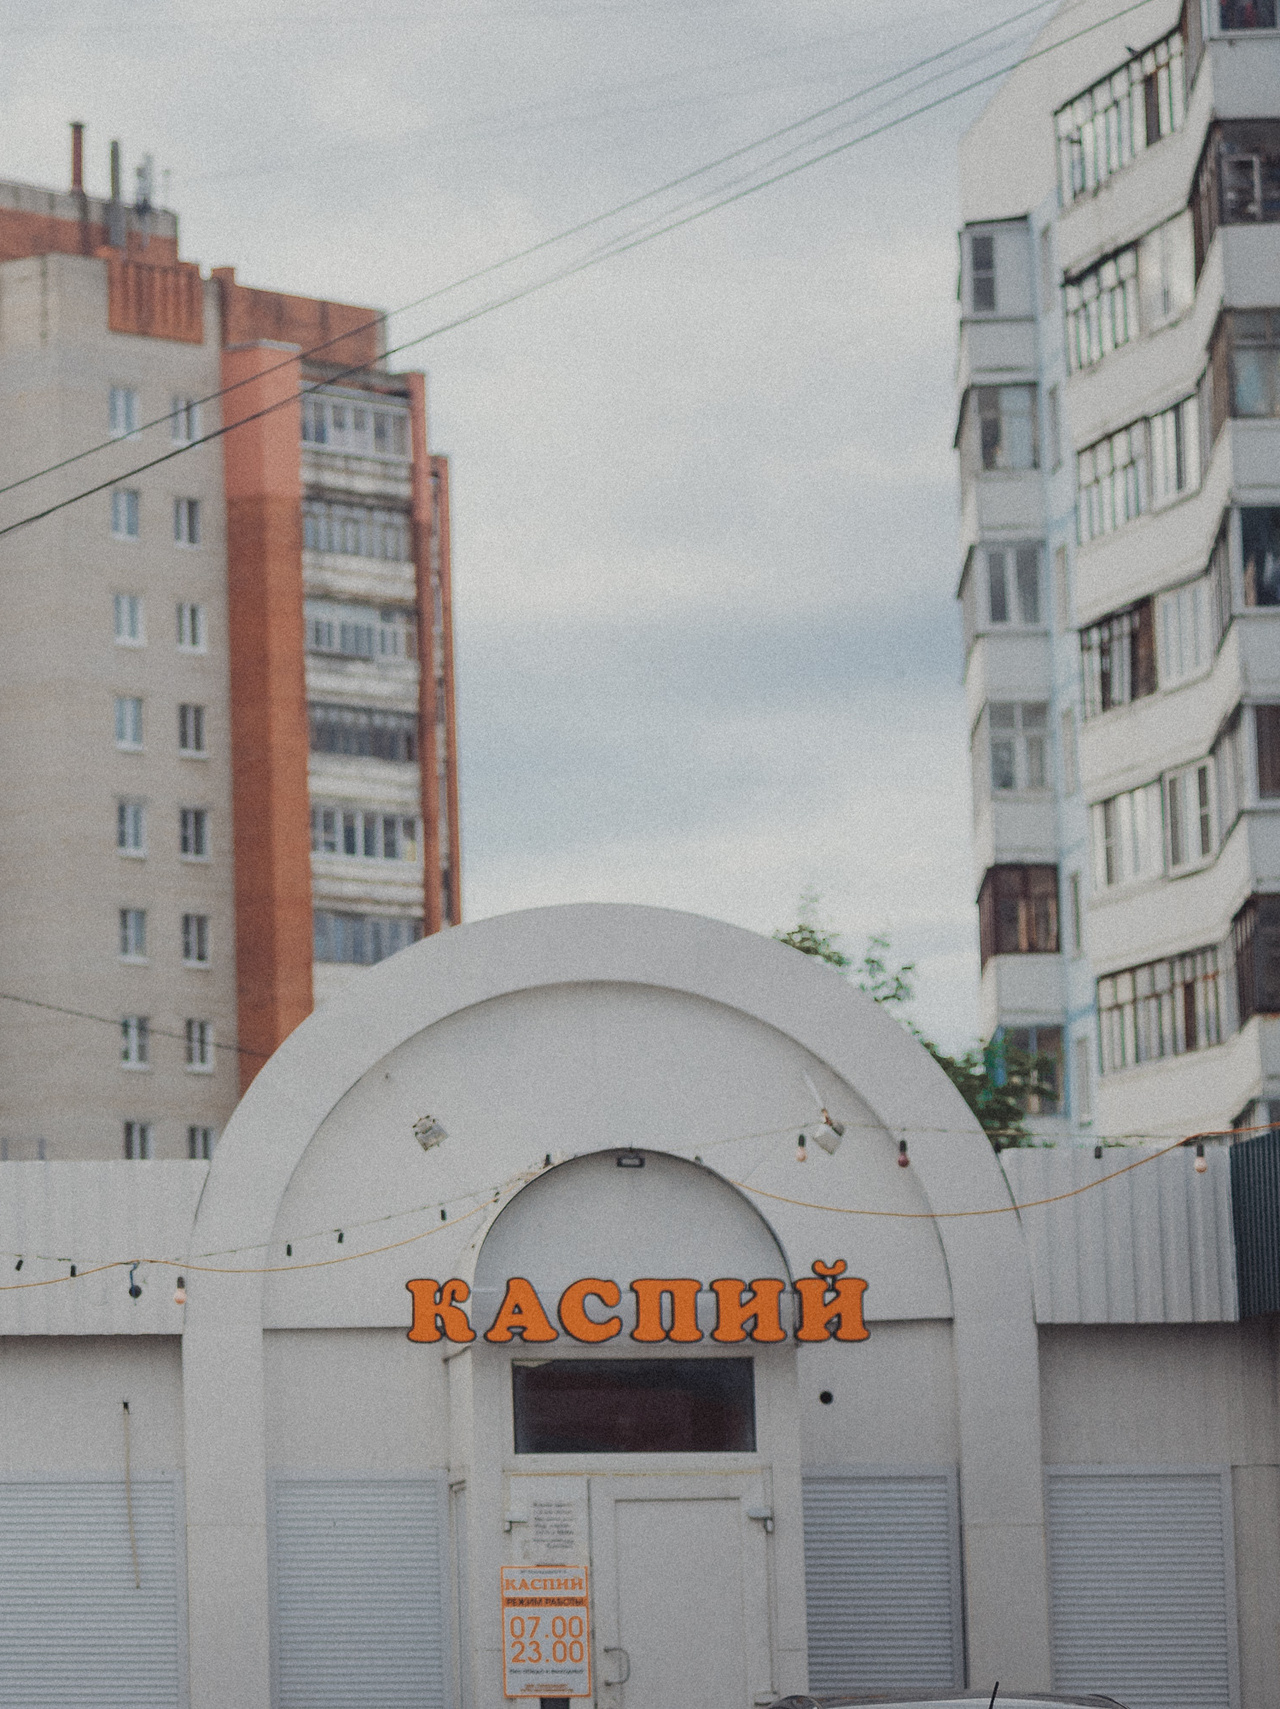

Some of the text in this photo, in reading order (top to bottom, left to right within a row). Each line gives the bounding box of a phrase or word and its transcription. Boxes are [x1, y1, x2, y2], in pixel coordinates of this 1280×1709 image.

[406, 1259, 870, 1344] КАСПИЙ
[505, 1579, 583, 1590] КАСПИЙ
[510, 1616, 583, 1638] 07.00
[511, 1641, 584, 1662] 23.00
